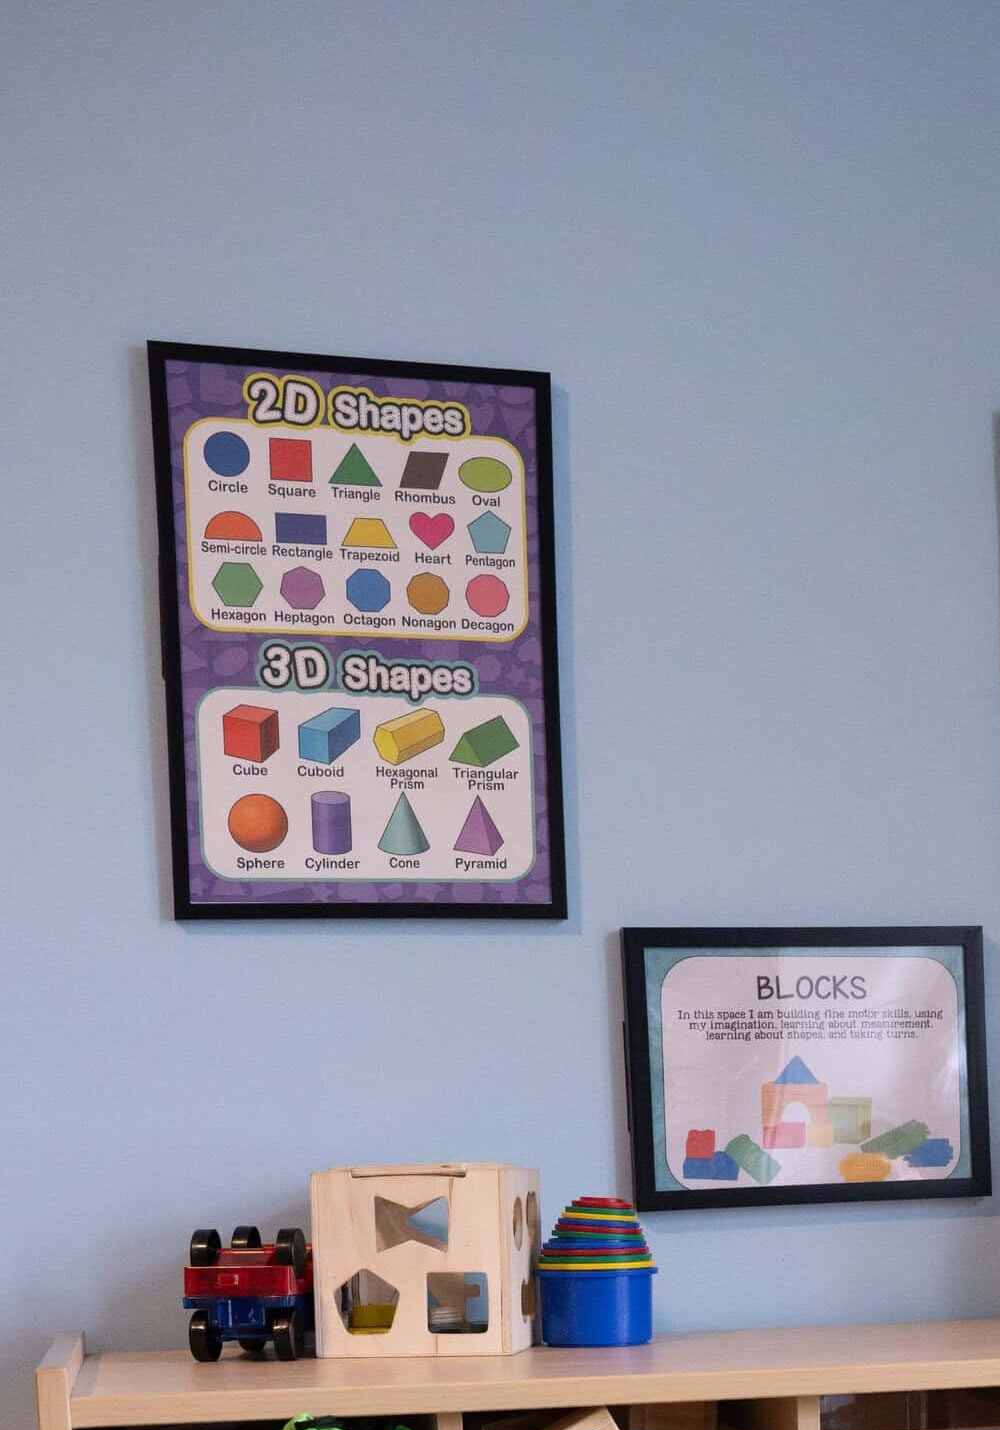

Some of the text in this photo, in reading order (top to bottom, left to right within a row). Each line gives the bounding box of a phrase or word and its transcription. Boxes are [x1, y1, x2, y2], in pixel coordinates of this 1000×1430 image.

[246, 377, 465, 439] 2D Shapes
[208, 479, 249, 494] Circle
[268, 483, 316, 499] Square
[331, 487, 381, 502] Triangle
[394, 490, 456, 505] Rhombus
[471, 494, 501, 508] Oval
[201, 541, 267, 557] Semi-circle
[272, 545, 333, 561] Rectangle
[340, 548, 400, 565] Trapezoid
[414, 552, 451, 565] Heart
[465, 554, 516, 570] Pentagon
[211, 609, 266, 625] Hexagon
[274, 610, 335, 626] Heptagon
[343, 613, 396, 629] Octagon
[402, 616, 456, 631] Nonagon
[461, 619, 514, 633] Decagon
[260, 644, 474, 701] 3D Shapes
[232, 764, 268, 778] Cube
[296, 765, 345, 778] Cuboid
[375, 766, 438, 781] Hexagonal
[452, 767, 519, 782] Triangular
[390, 777, 425, 791] Prism
[468, 779, 505, 791] Prism
[236, 857, 285, 872] Sphere
[305, 857, 360, 872] Cylinder
[389, 858, 421, 870] Cone
[455, 857, 508, 871] Pyramid
[756, 975, 867, 1000] BLOCKS
[677, 1009, 690, 1020] In
[694, 1010, 714, 1020] this
[716, 1010, 746, 1021] space
[749, 1009, 754, 1019] I
[757, 1010, 774, 1020] am
[777, 1009, 820, 1020] building
[825, 1009, 844, 1019] fine
[848, 1009, 880, 1019] motor
[914, 1009, 943, 1020] using
[689, 1021, 706, 1031] my
[710, 1020, 778, 1031] imagination,
[781, 1020, 825, 1030] learning
[829, 1020, 856, 1029] about
[706, 1030, 751, 1041] learning
[755, 1030, 783, 1040] about
[829, 1030, 847, 1039] and
[850, 1029, 882, 1040] taking
